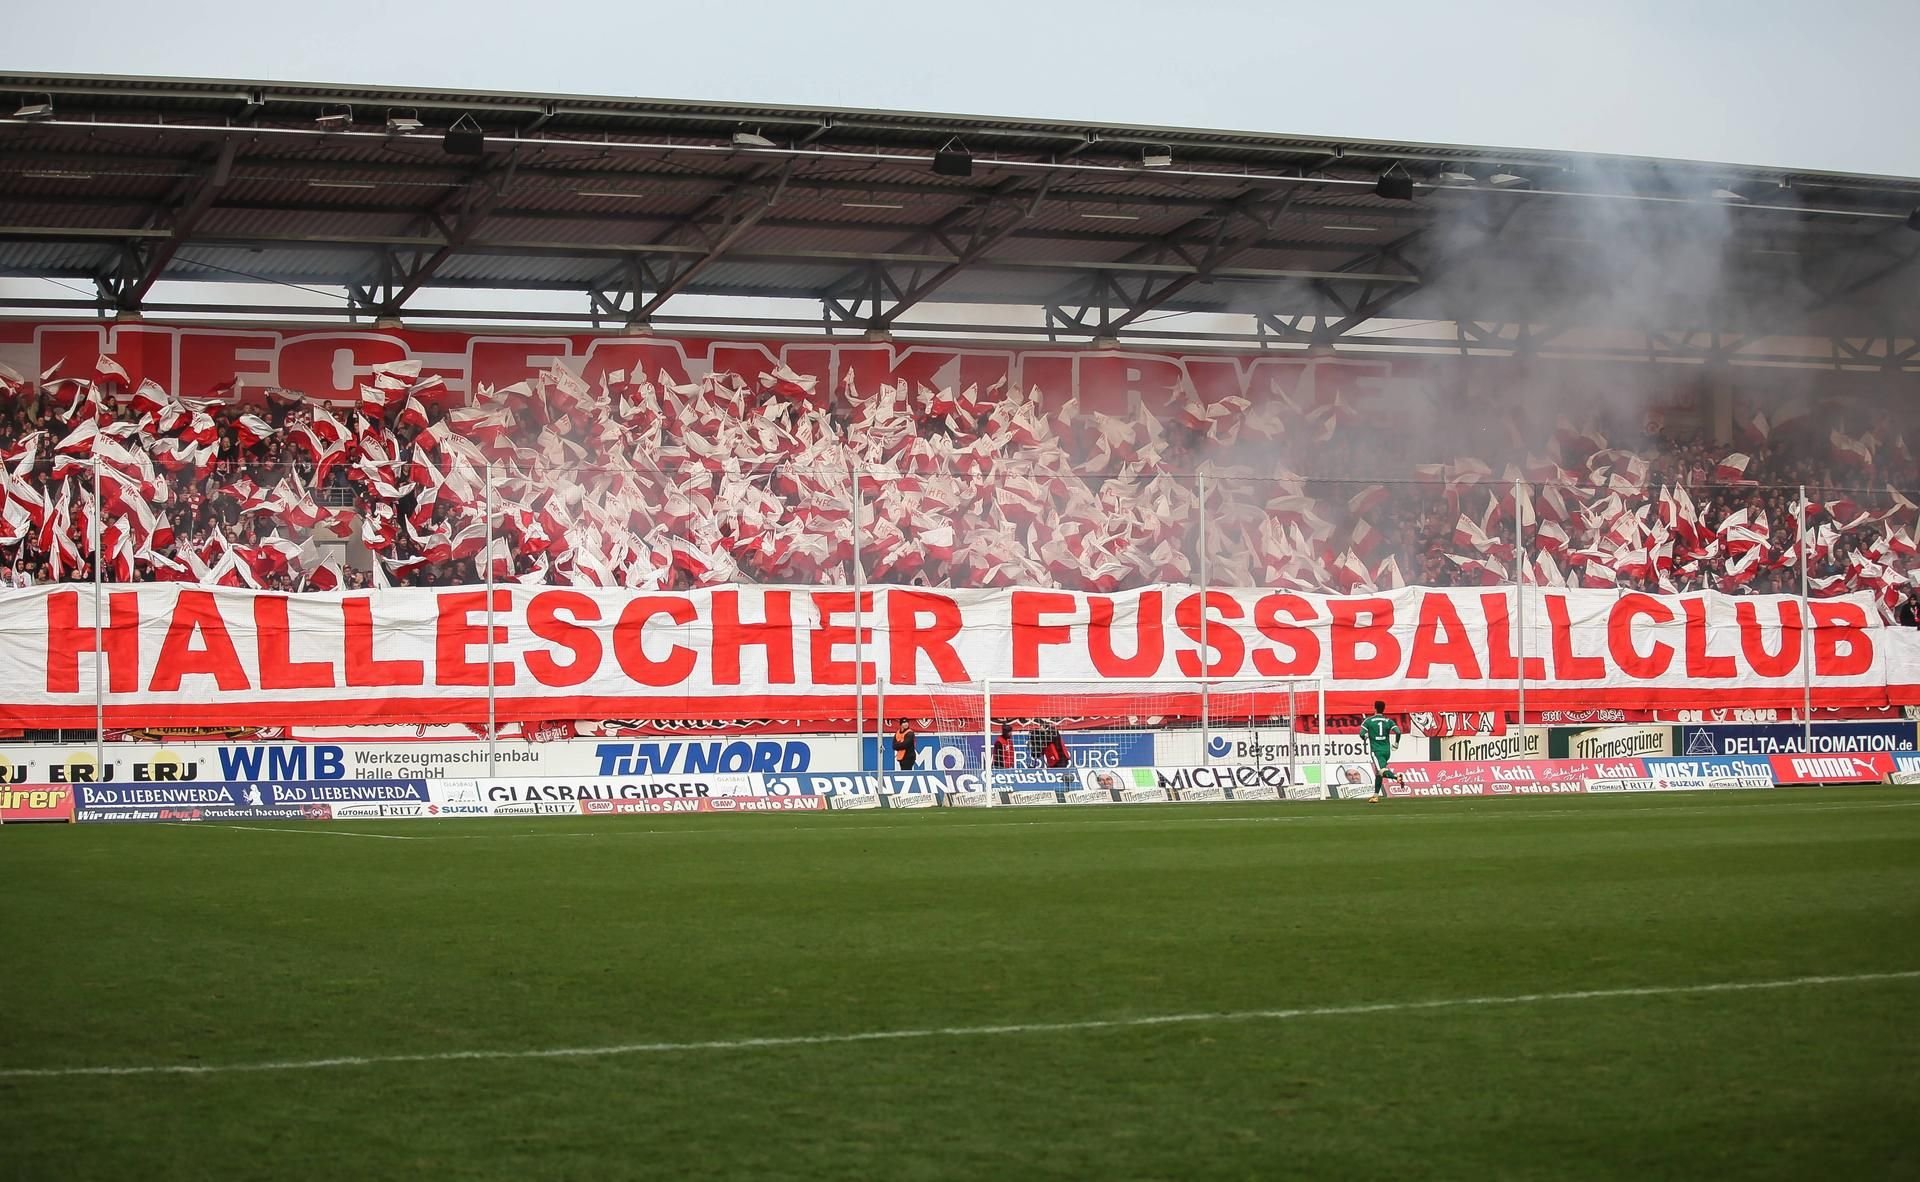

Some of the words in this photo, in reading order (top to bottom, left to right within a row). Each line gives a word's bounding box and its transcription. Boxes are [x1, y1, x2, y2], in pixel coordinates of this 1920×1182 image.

[100, 436, 115, 446] HFC
[451, 434, 464, 443] HFC
[929, 488, 946, 499] HFC
[816, 499, 831, 507] HFC
[632, 537, 643, 550] HFC
[46, 589, 968, 694] HALLESCHER
[1012, 591, 1874, 682] FUSSBALLCLUB
[1378, 722, 1383, 736] 1
[1237, 740, 1369, 761] Bergmannstrost
[1577, 730, 1664, 758] Wernesgrüner
[1724, 735, 1913, 755] DELTA-AUTOMATION.de
[218, 746, 345, 781] WMB
[355, 750, 539, 766] Werkzeugmaschinenbau
[683, 741, 811, 774] NORD
[134, 762, 197, 782] ERU
[355, 768, 393, 779] Halle
[398, 767, 445, 779] GmbH
[1490, 765, 1536, 781] Kathi
[1594, 763, 1638, 779] Kathi
[1703, 761, 1729, 777] Fan
[1792, 757, 1857, 778] PUMA
[810, 774, 984, 796] PRINZING
[1415, 784, 1451, 795] radio
[1452, 783, 1483, 794] SAW
[1515, 782, 1551, 793] radio
[1552, 782, 1581, 792] SAW
[1622, 780, 1655, 790] FRITZ
[1669, 780, 1704, 788] SUZUKI
[1737, 777, 1769, 788] FRITZ
[83, 787, 118, 803] BAD
[122, 785, 234, 803] LIEBENWERDA
[272, 785, 307, 801] BAD
[311, 783, 420, 801] LIEBENWERDA
[488, 785, 612, 801] GLASBAU
[620, 783, 709, 799] GIPSER
[379, 803, 422, 816] FRITZ
[442, 804, 489, 813] SUZUKI
[534, 802, 576, 814] FRITZ
[617, 800, 661, 812] radio
[663, 799, 700, 812] SAW
[739, 798, 781, 811] radio
[784, 797, 819, 809] SAW
[78, 810, 102, 821] Wir
[104, 810, 158, 820] machen
[204, 809, 253, 817] druckerei
